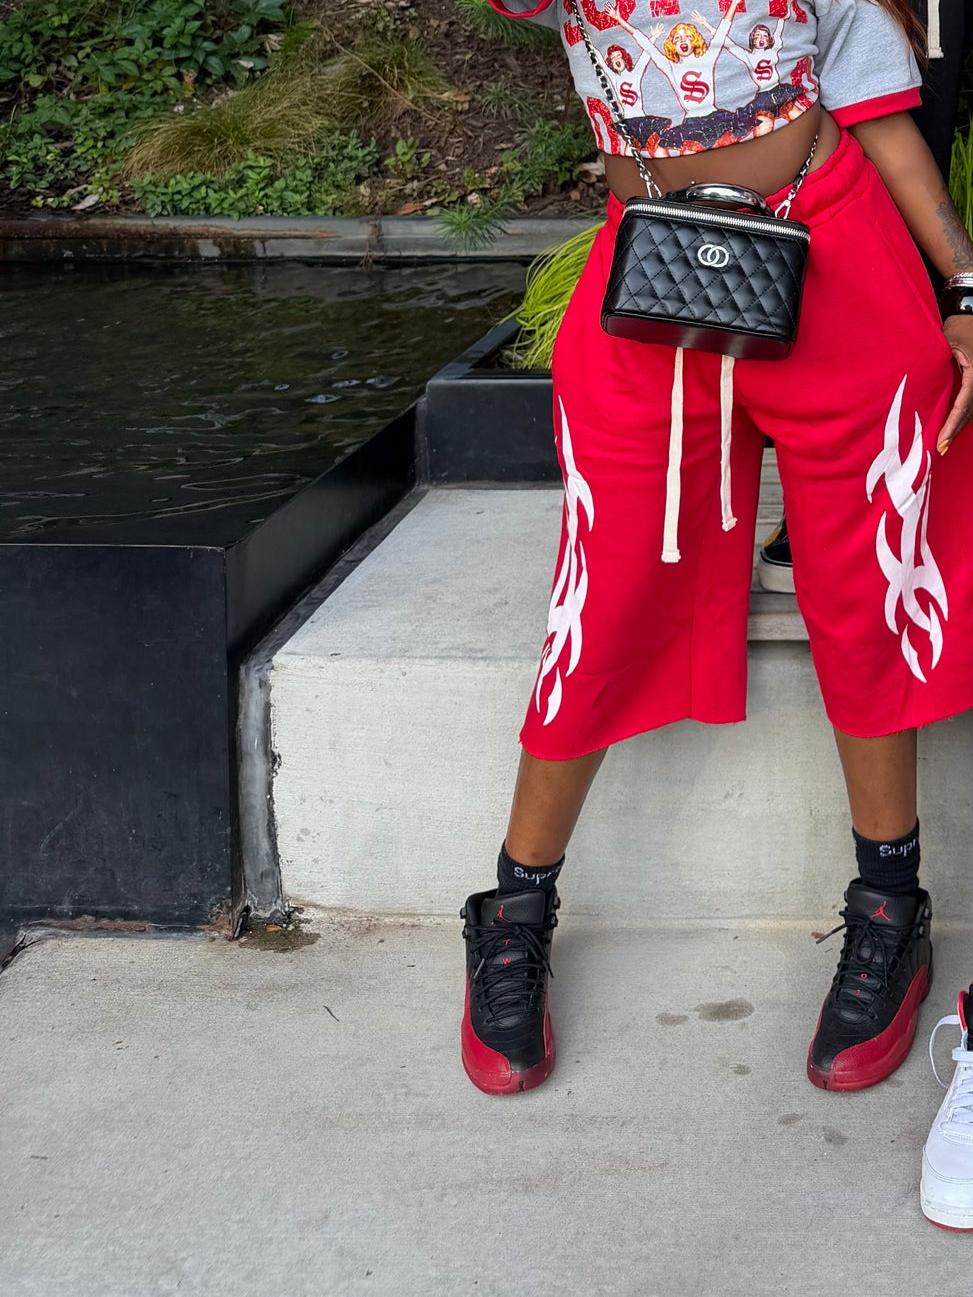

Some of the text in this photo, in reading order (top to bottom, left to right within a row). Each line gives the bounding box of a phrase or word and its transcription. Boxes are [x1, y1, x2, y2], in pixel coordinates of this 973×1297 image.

[754, 59, 774, 81] S
[619, 81, 639, 107] S
[680, 70, 710, 104] S
